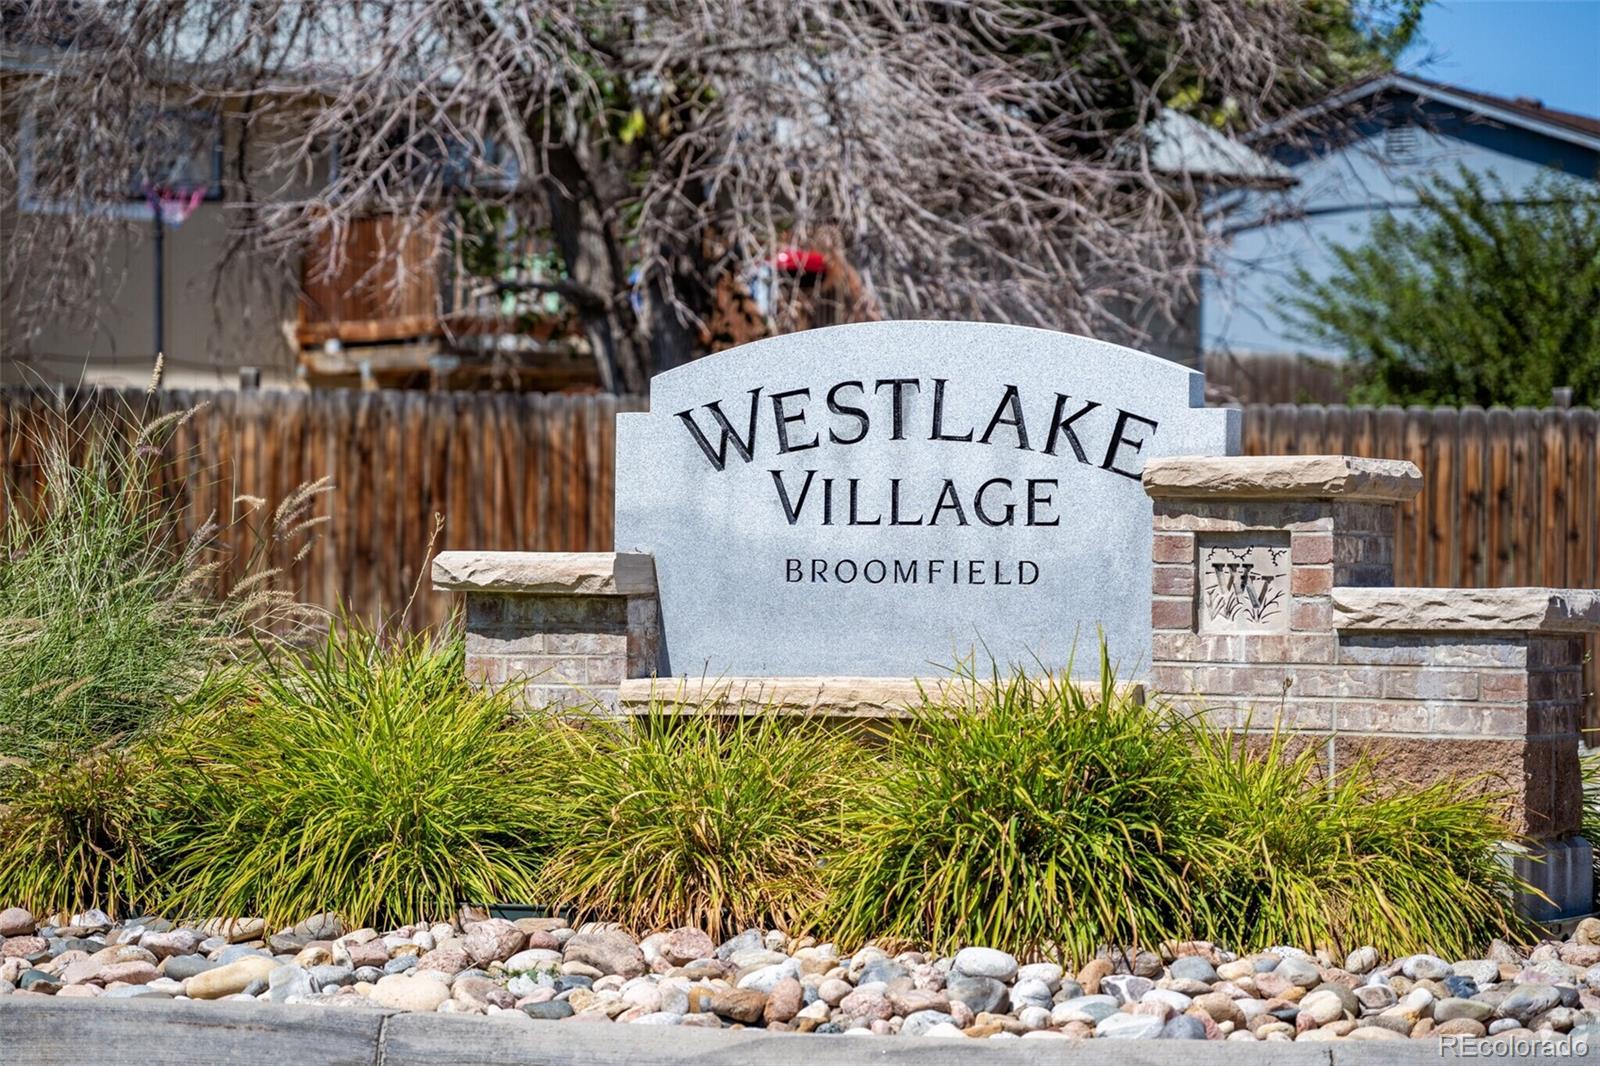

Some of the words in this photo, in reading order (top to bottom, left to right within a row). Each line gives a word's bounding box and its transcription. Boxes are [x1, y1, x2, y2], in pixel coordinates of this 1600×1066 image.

[673, 377, 1160, 482] WESTLAKE
[767, 469, 1061, 527] VILLAGE
[785, 558, 1041, 585] BROOMFIELD
